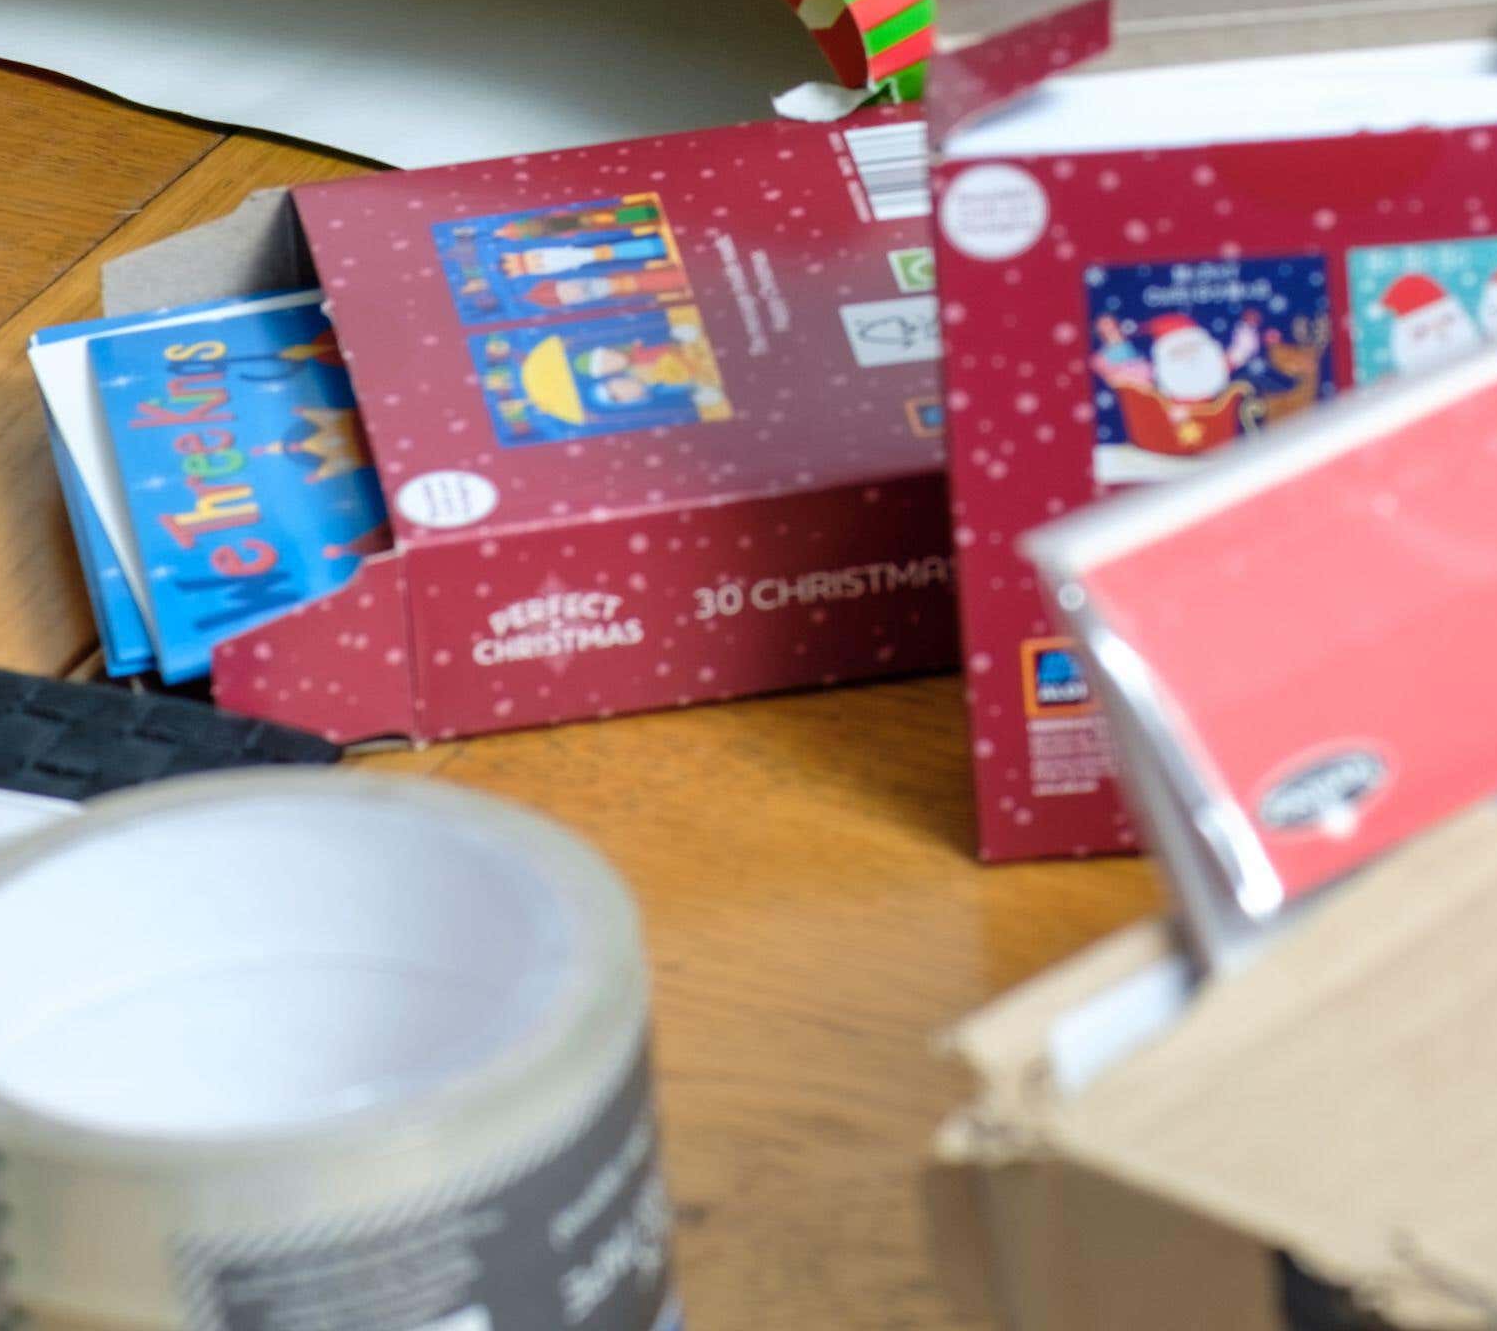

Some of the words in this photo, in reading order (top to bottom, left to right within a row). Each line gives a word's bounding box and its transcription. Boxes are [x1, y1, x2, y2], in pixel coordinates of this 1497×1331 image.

[158, 426, 261, 549] Three
[173, 538, 303, 631] We
[694, 582, 745, 620] 30
[489, 591, 623, 636] PERFECT
[472, 617, 644, 667] CHRISTMAS
